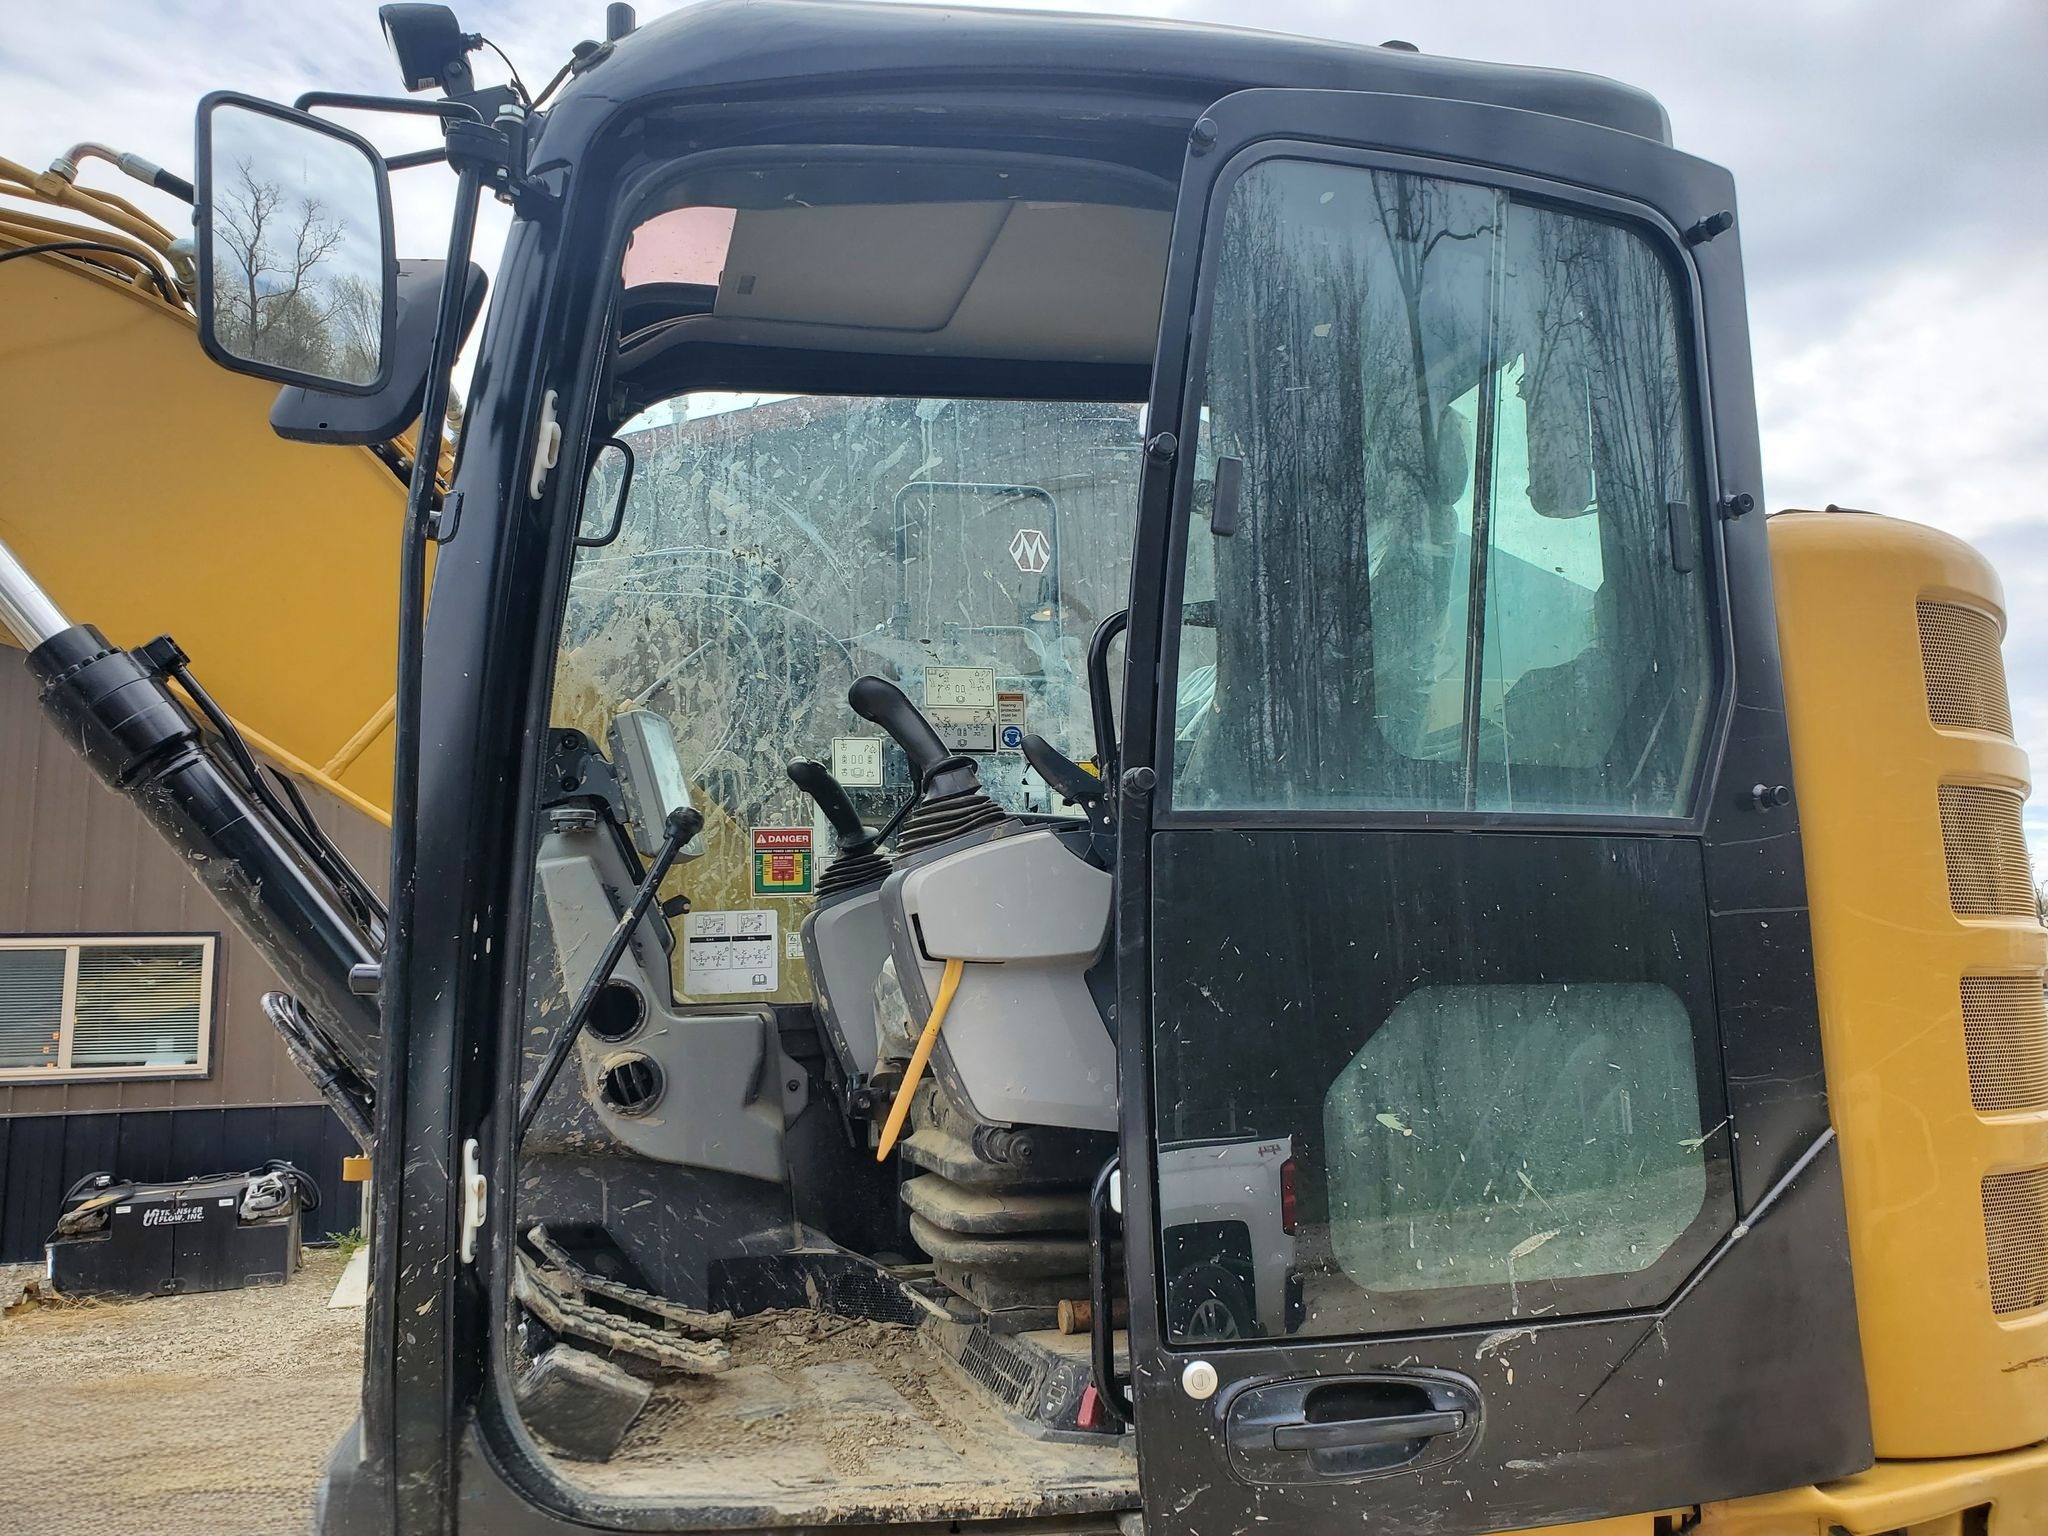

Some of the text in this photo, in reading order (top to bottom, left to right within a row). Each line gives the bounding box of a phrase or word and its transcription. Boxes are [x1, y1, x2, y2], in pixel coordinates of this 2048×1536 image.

[768, 835, 809, 843] DANGER
[159, 1212, 205, 1223] FLOW, INC.
